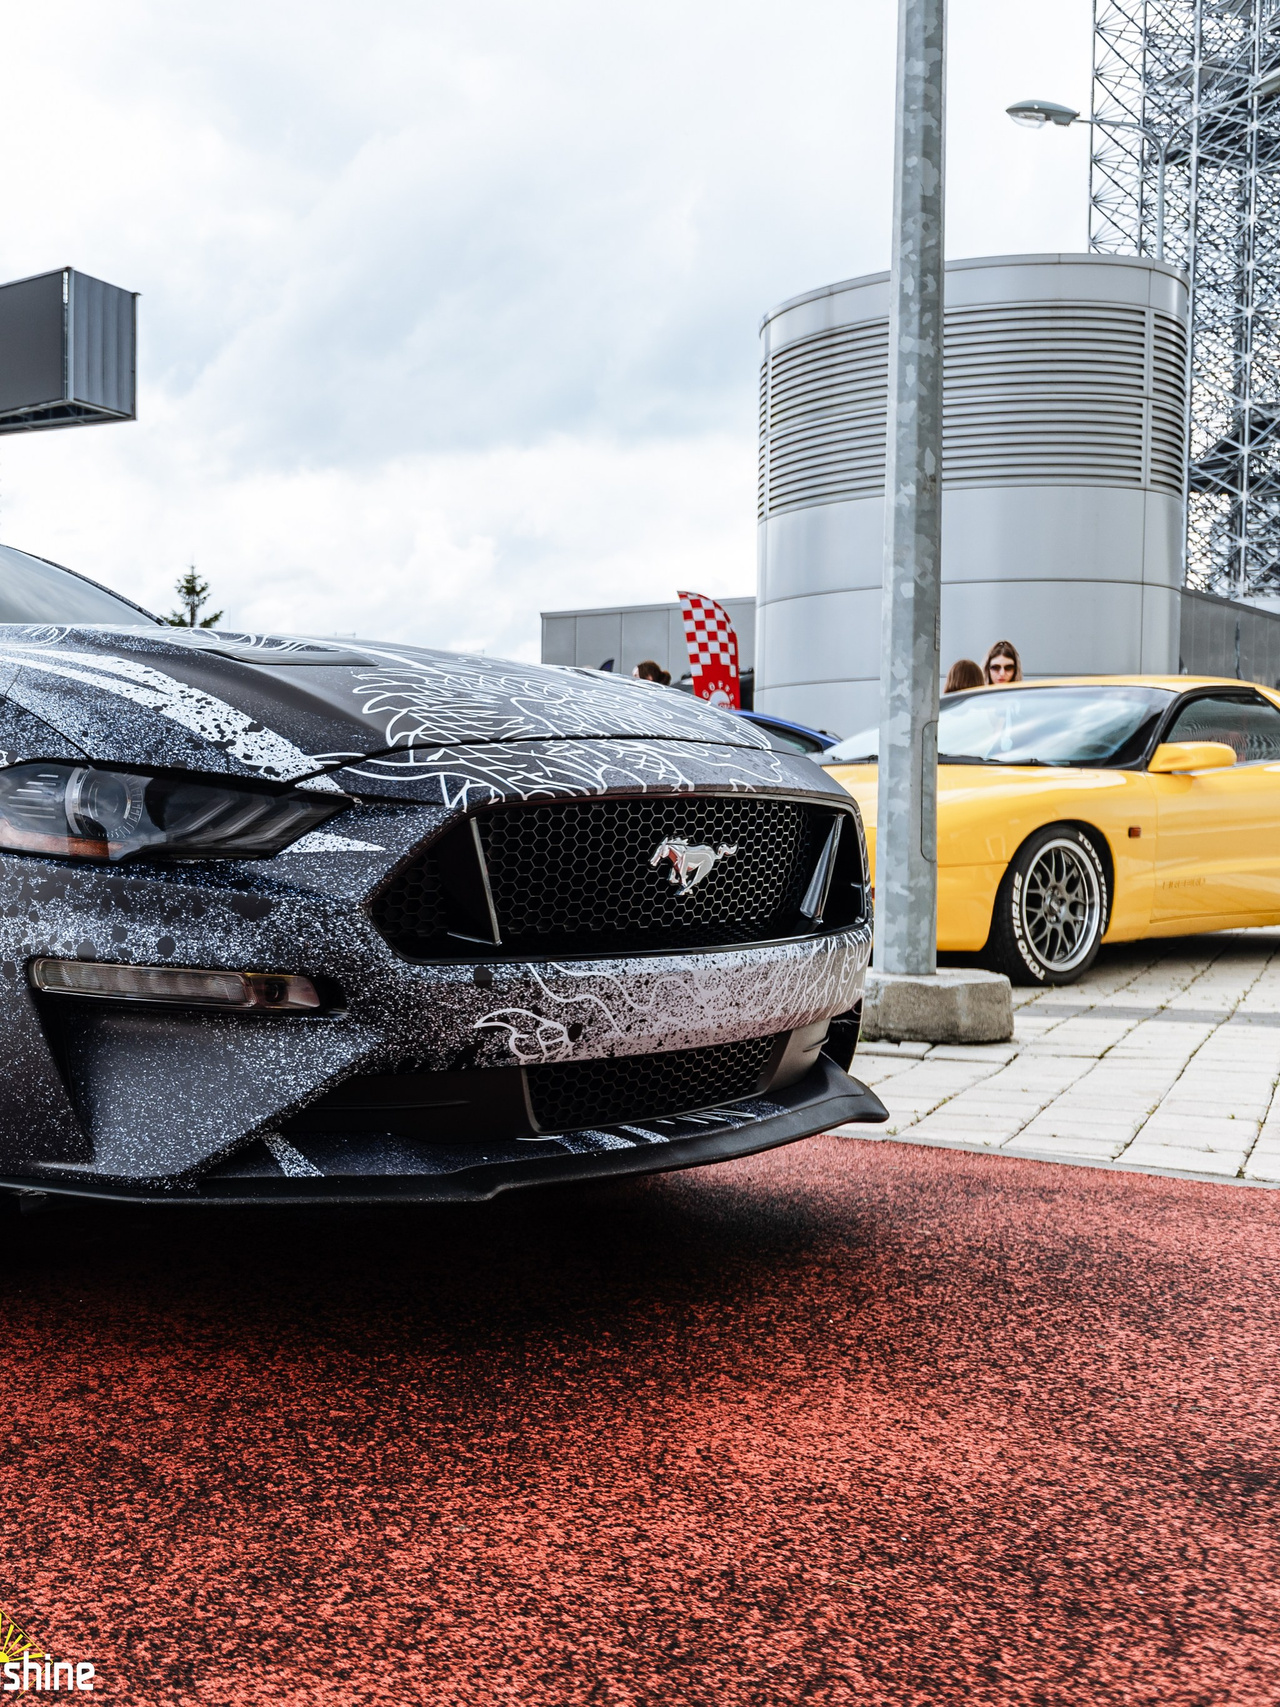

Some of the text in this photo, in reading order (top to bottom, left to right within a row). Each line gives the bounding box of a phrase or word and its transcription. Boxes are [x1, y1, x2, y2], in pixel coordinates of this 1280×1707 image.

[1079, 831, 1102, 873] TOYO
[1012, 872, 1045, 980] TOYO TIRES
